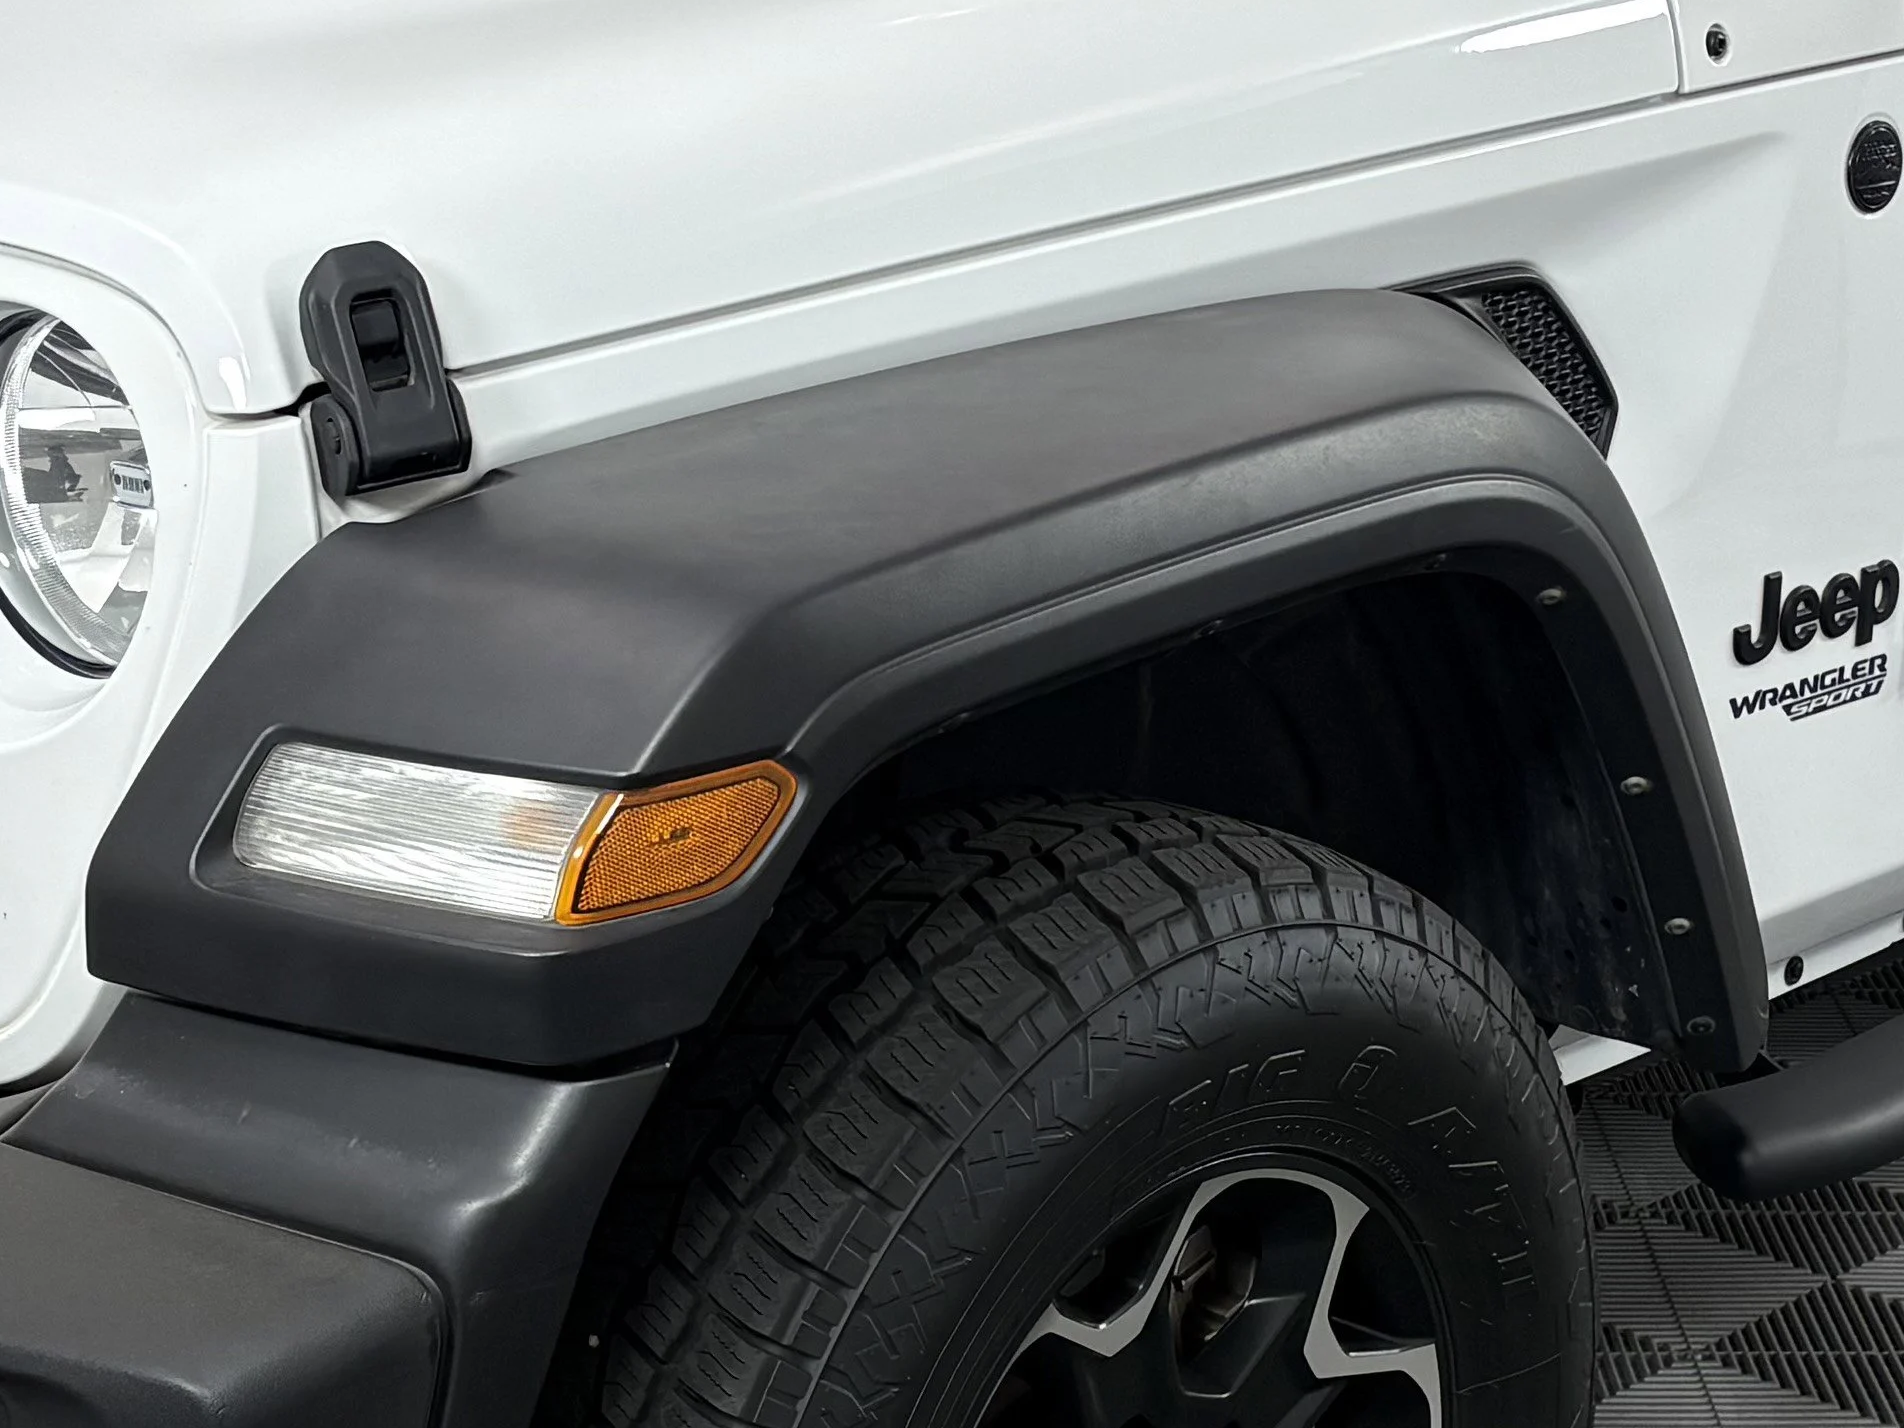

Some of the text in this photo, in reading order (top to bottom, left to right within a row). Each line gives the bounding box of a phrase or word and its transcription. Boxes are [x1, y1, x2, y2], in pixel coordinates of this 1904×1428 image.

[1732, 559, 1900, 666] Jeep
[1729, 653, 1887, 719] WRANGLER
[1788, 678, 1886, 719] SPORT
